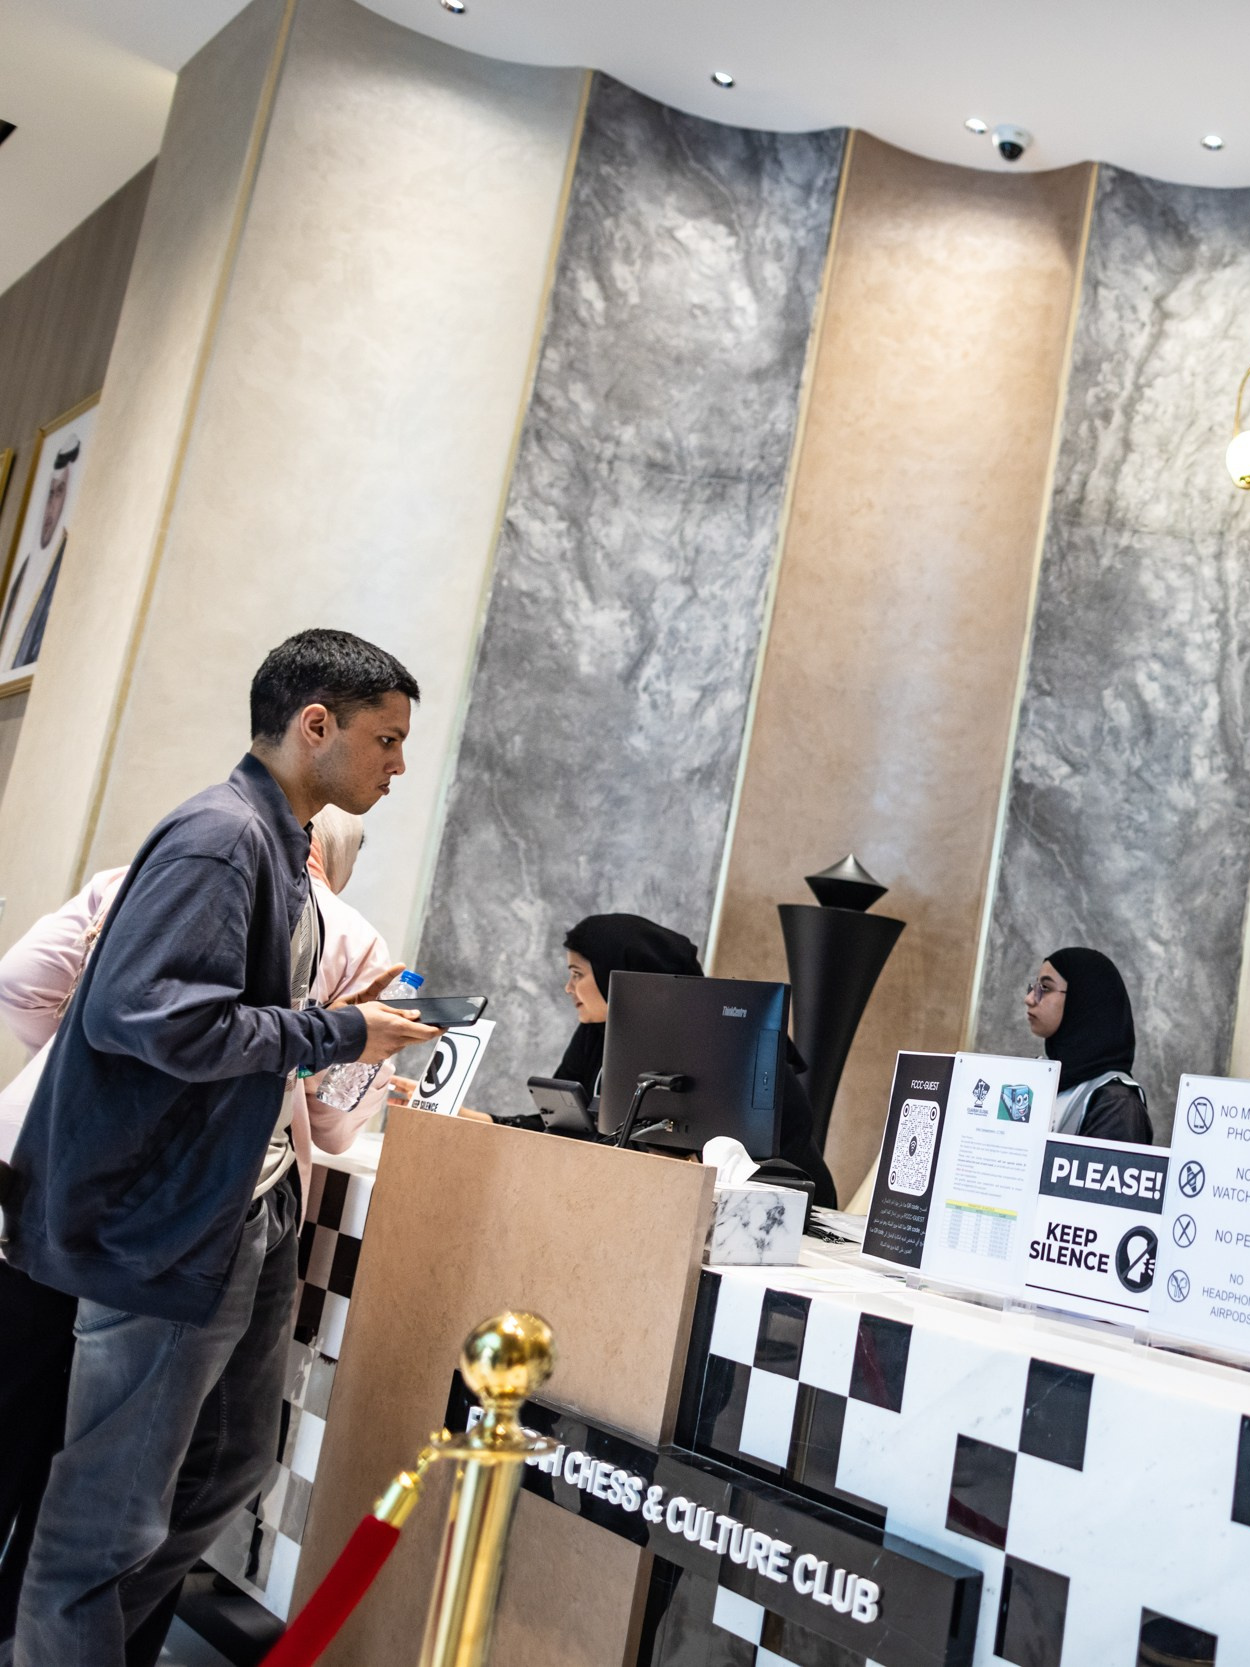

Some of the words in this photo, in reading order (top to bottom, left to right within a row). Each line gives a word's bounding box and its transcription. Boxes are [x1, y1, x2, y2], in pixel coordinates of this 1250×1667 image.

[419, 1100, 438, 1112] SILENCE
[1220, 1105, 1238, 1118] NO
[1050, 1157, 1164, 1200] PLEASE!
[1046, 1222, 1098, 1247] KEEP
[1215, 1229, 1233, 1244] NO
[1029, 1240, 1110, 1273] SILENCE
[1229, 1273, 1244, 1286] NO
[563, 1450, 643, 1512] CHESS
[642, 1484, 664, 1524] &
[665, 1495, 793, 1583] CULTURE
[793, 1553, 881, 1624] CLUB
